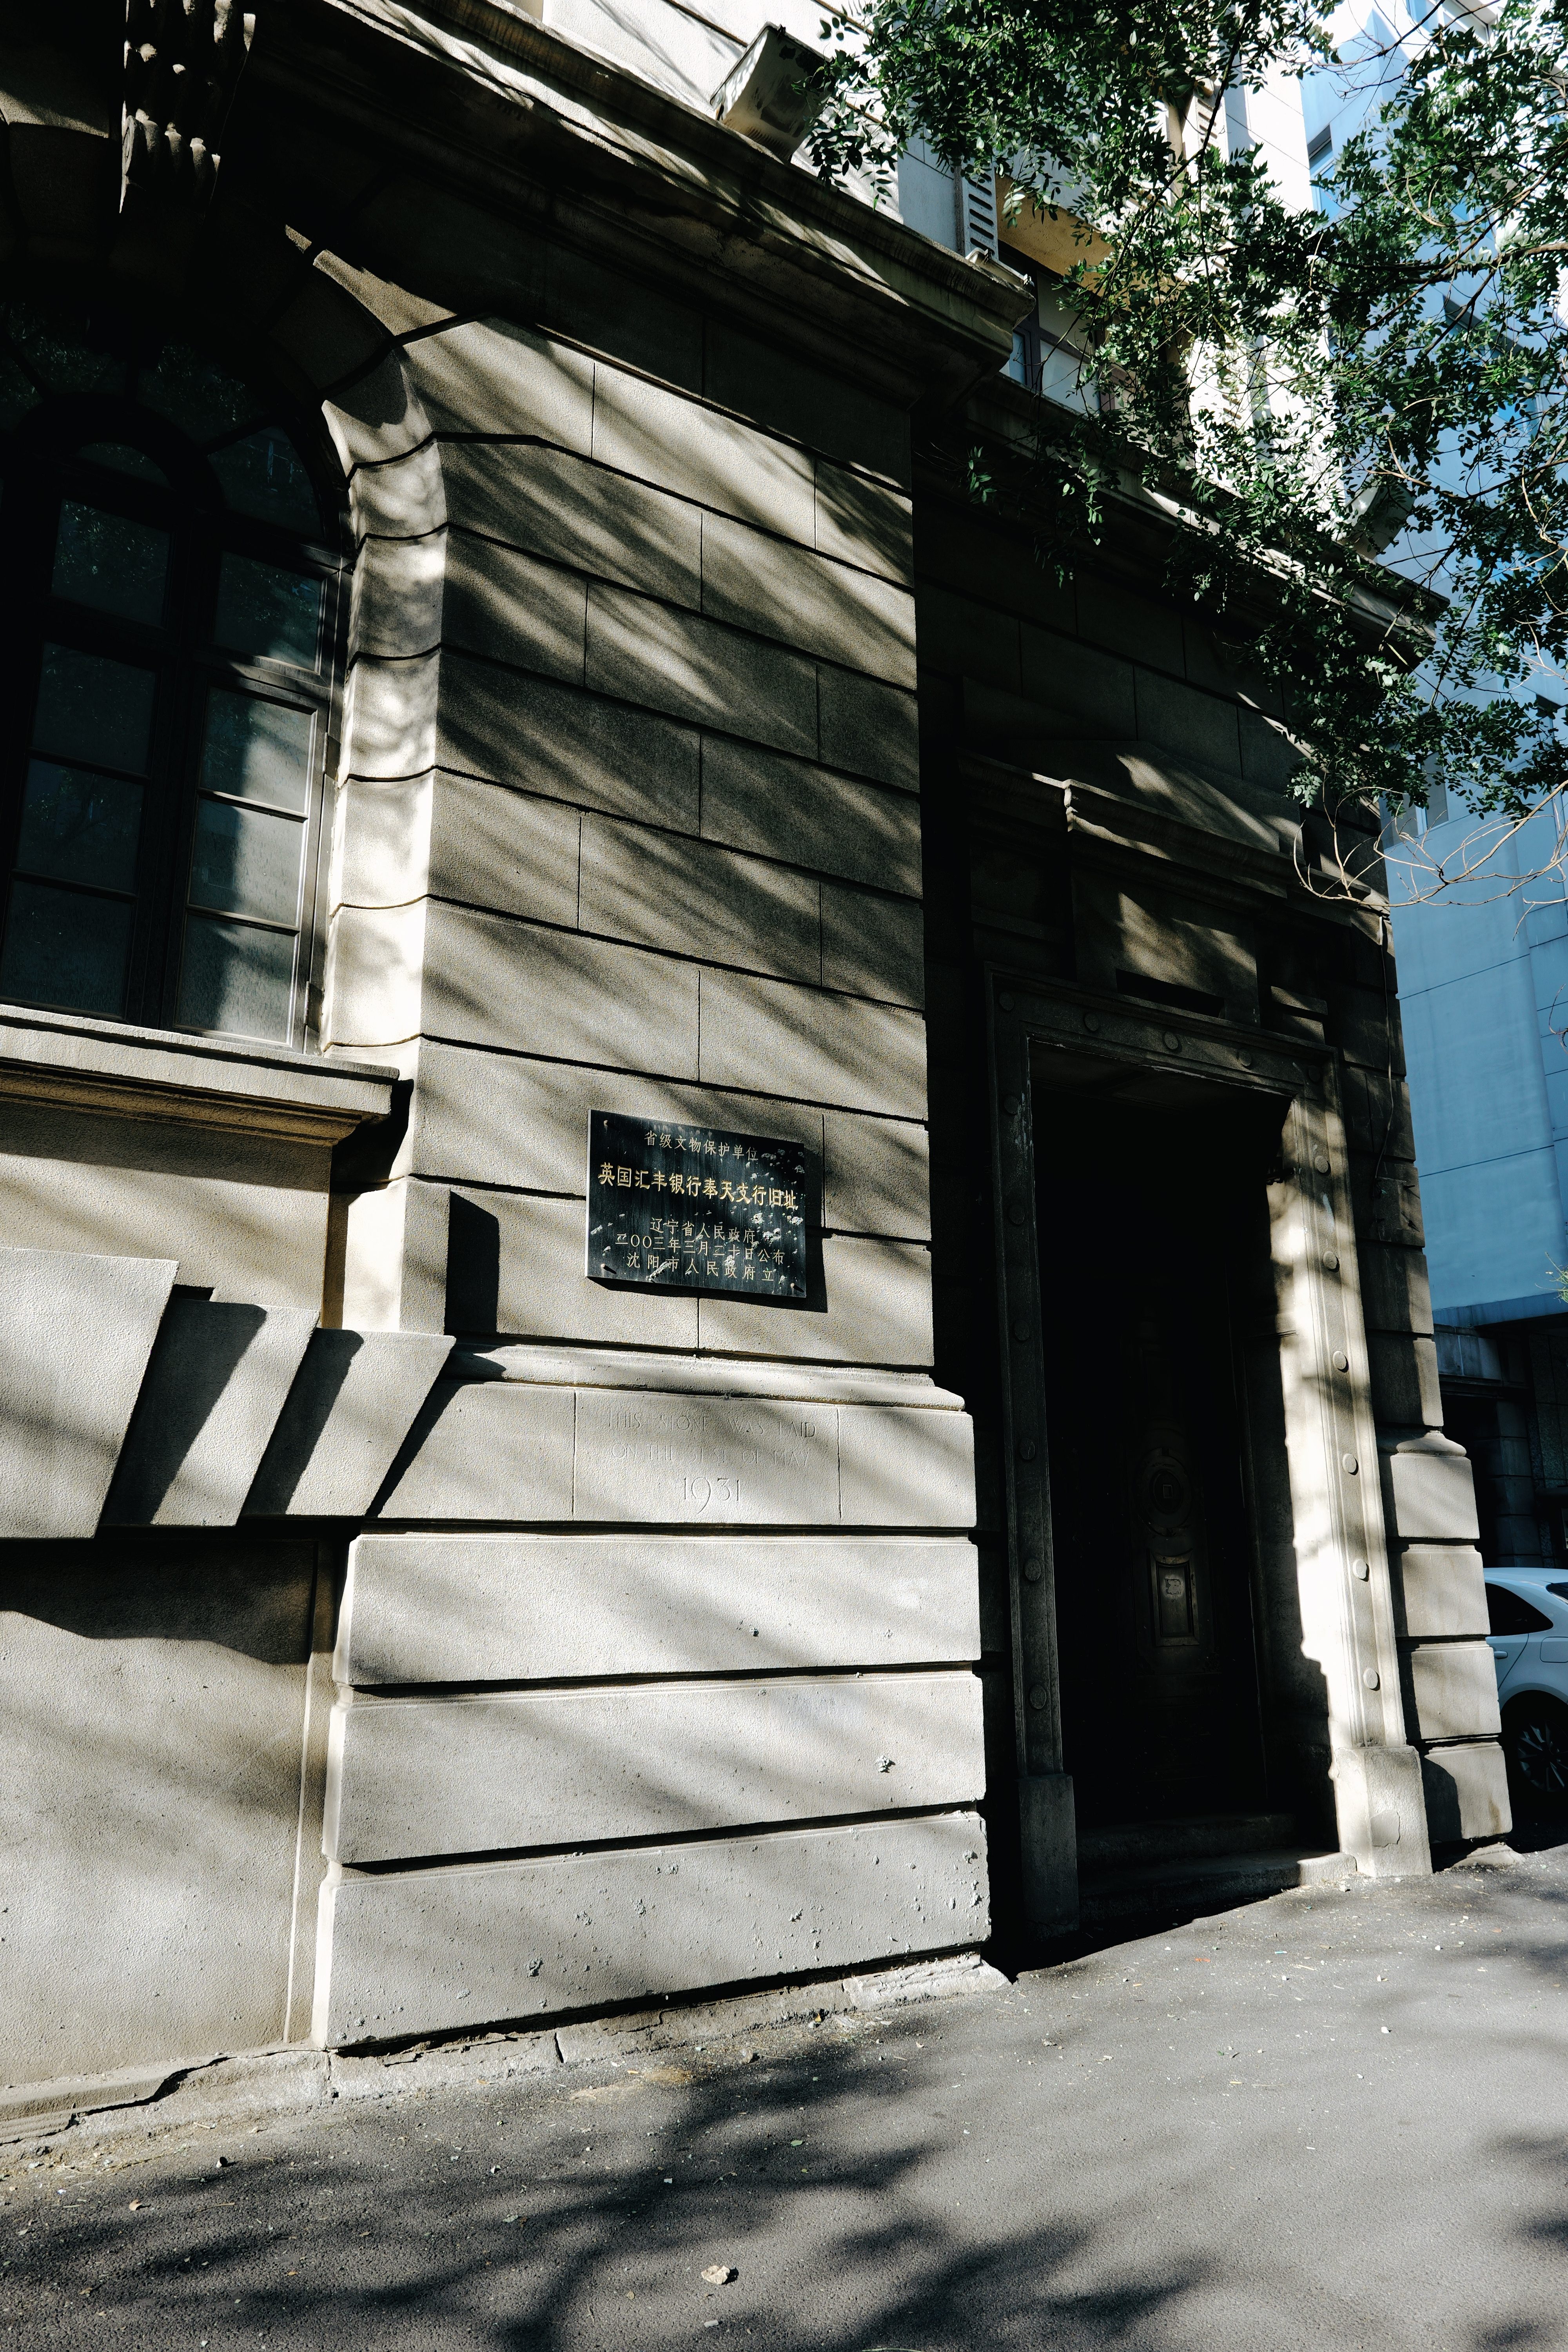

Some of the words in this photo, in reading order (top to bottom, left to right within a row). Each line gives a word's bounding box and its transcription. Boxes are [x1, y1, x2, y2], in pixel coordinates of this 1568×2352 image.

[644, 1131, 759, 1161] 省级文物保护单位
[598, 1162, 798, 1209] 英国汇丰银行奉天支行旧址
[650, 1218, 755, 1243] 辽宁省人民政府
[607, 1408, 642, 1428] THIS
[727, 1417, 765, 1436] WAS
[611, 1442, 637, 1461] ON
[773, 1447, 811, 1467] MAY
[684, 1477, 741, 1515] 1931
